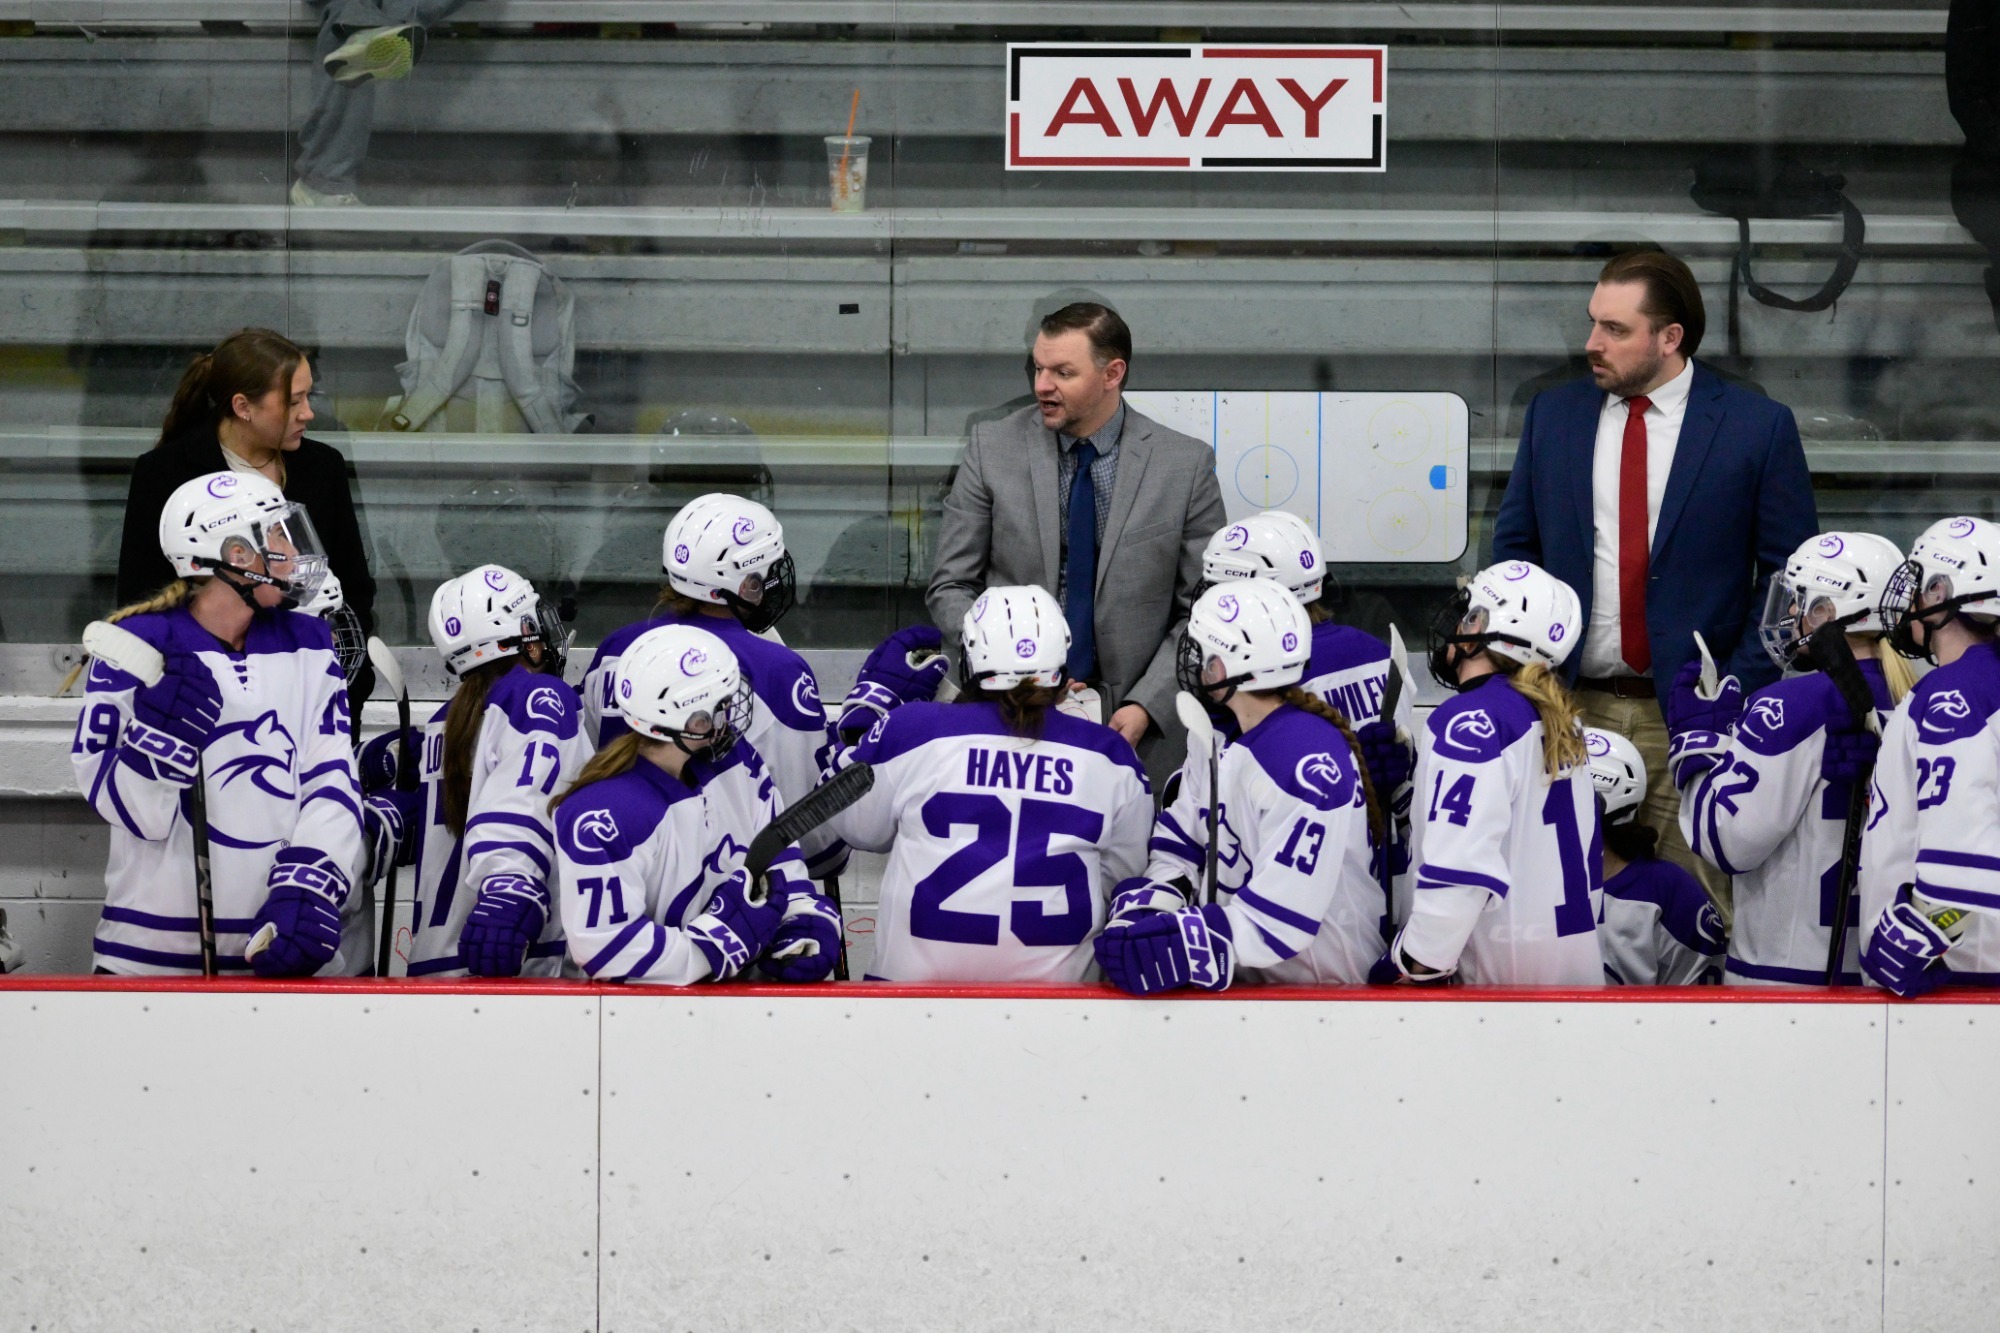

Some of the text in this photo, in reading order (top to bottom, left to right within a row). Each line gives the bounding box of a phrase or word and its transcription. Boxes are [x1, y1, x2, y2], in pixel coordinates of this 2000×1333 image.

[1043, 77, 1349, 138] AWAY
[208, 514, 238, 529] CCM
[267, 553, 287, 561] CCM
[741, 554, 765, 568] CCM
[1932, 551, 1958, 566] CCM
[243, 571, 274, 584] CCM
[1224, 568, 1248, 579] CCM
[1816, 575, 1843, 587] CCM
[511, 594, 527, 609] CCM
[1481, 585, 1500, 602] CCM
[446, 618, 459, 635] 17
[1550, 624, 1563, 641] 14
[1017, 641, 1035, 656] 25
[1207, 634, 1230, 650] CCM
[1284, 635, 1296, 651] 13
[682, 691, 710, 708] CCM
[71, 703, 120, 755] 19
[515, 740, 561, 796] 17
[966, 747, 1075, 796] HAYES
[1590, 772, 1614, 784] CM
[1916, 756, 1957, 812] 23
[1427, 768, 1477, 828] 14
[1274, 815, 1327, 876] 13
[909, 790, 1105, 947] 25
[266, 864, 348, 910] CCM
[576, 875, 629, 928] 71
[1178, 905, 1213, 984] CM
